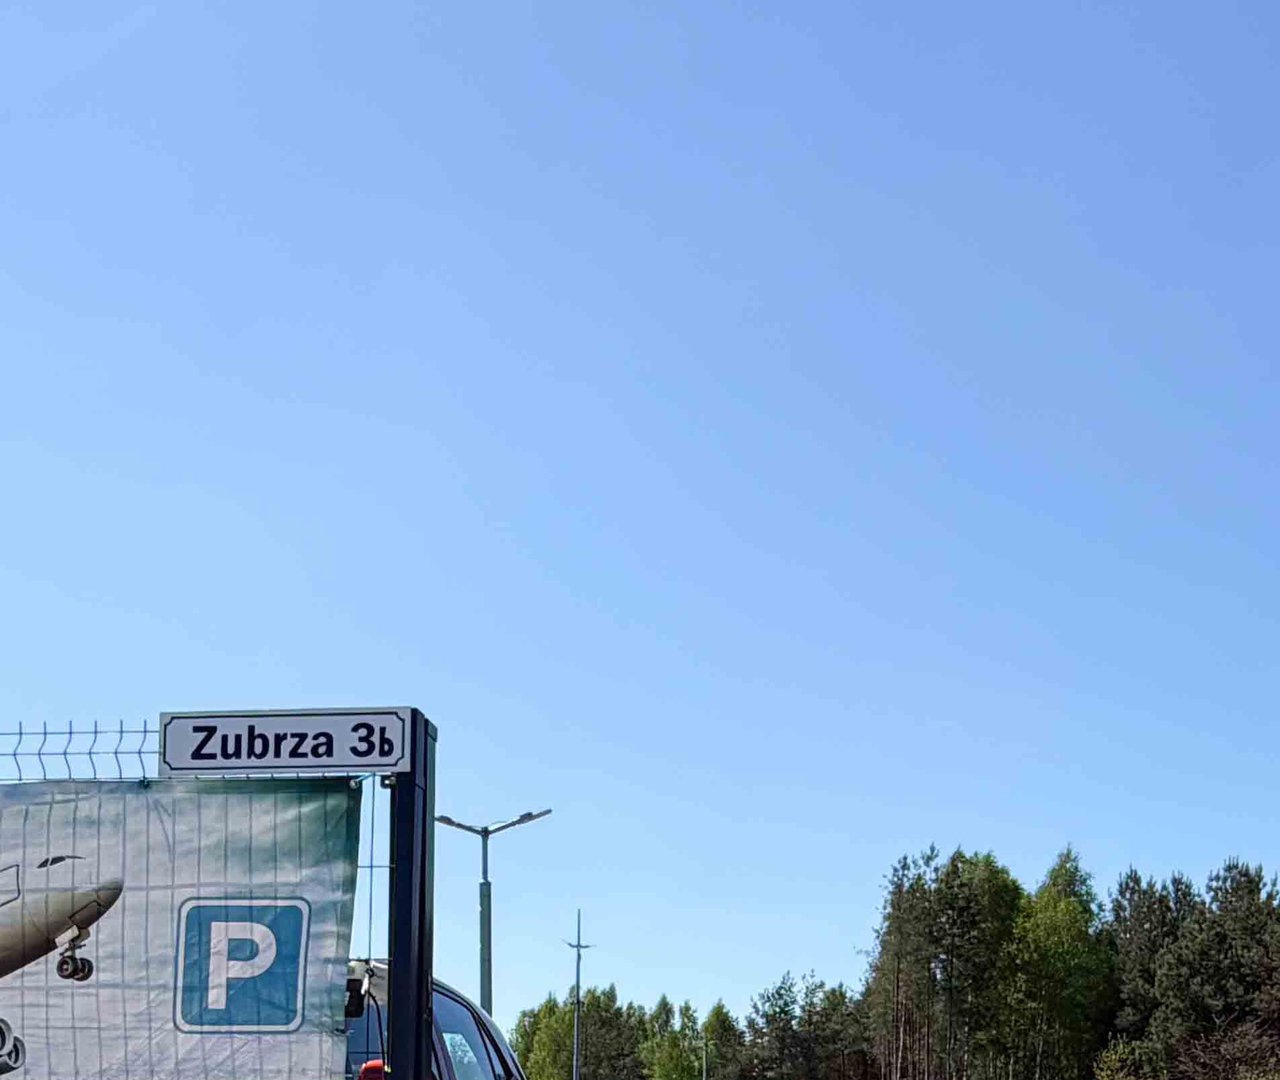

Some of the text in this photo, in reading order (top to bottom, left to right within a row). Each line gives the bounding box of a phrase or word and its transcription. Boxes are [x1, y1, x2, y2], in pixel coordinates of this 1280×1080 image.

[191, 722, 395, 761] Zubrza 3b
[207, 921, 277, 1009] P
